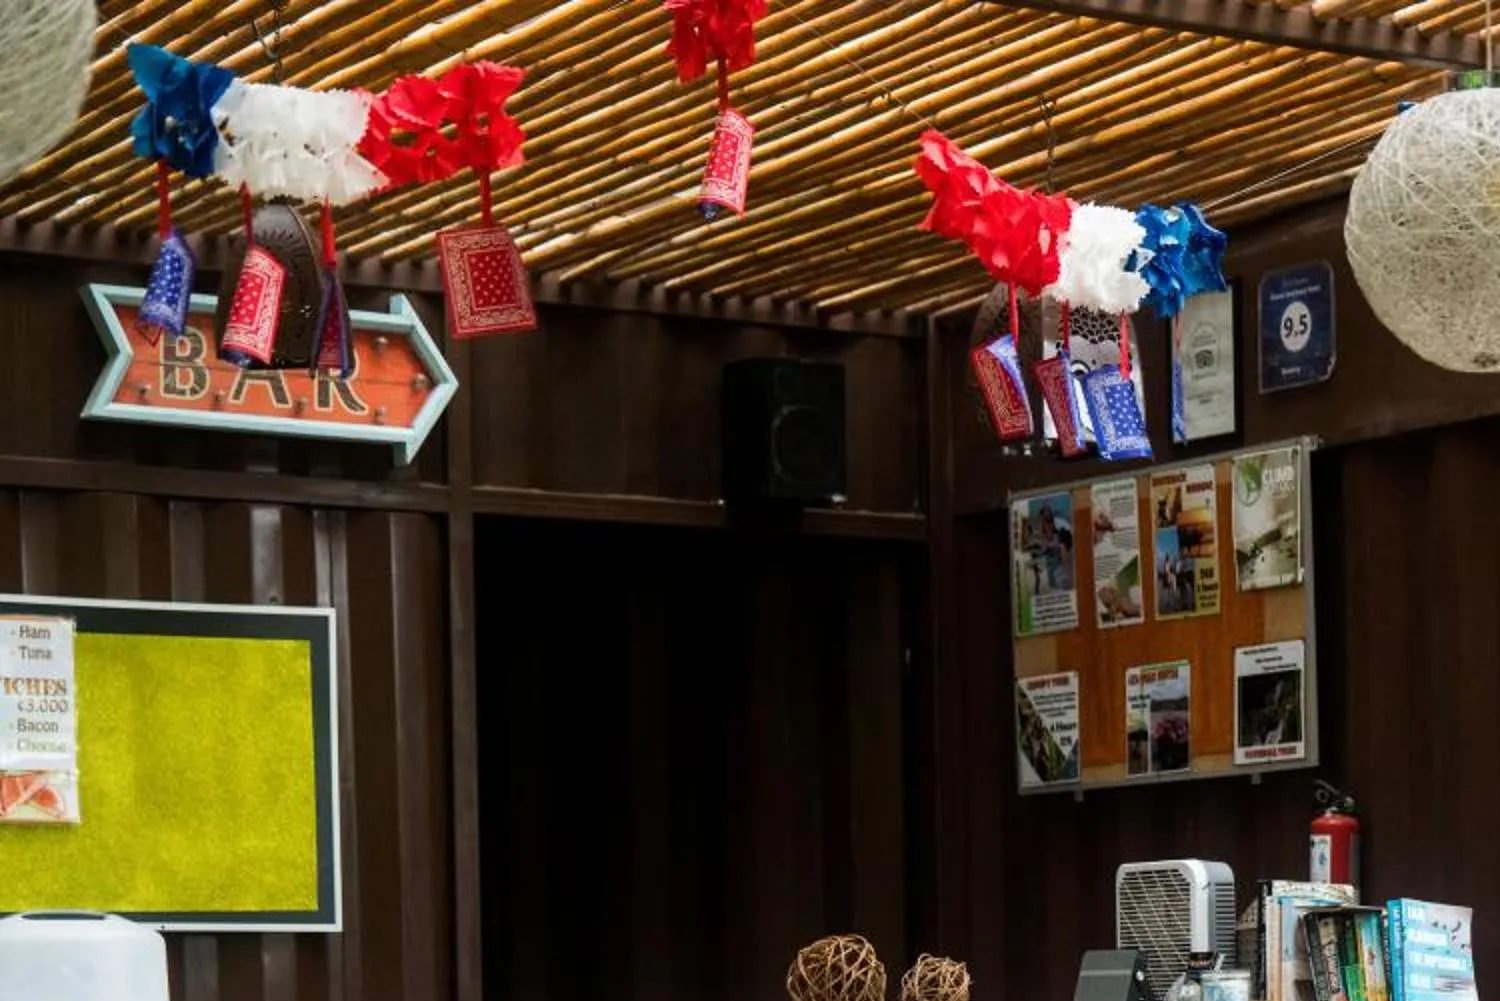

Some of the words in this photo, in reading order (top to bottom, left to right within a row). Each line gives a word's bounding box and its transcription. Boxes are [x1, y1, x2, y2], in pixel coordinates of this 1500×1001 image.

[19, 625, 51, 639] Ham
[18, 646, 52, 660] Tuna
[0, 677, 67, 696] ICHES
[17, 719, 59, 733] Bacon
